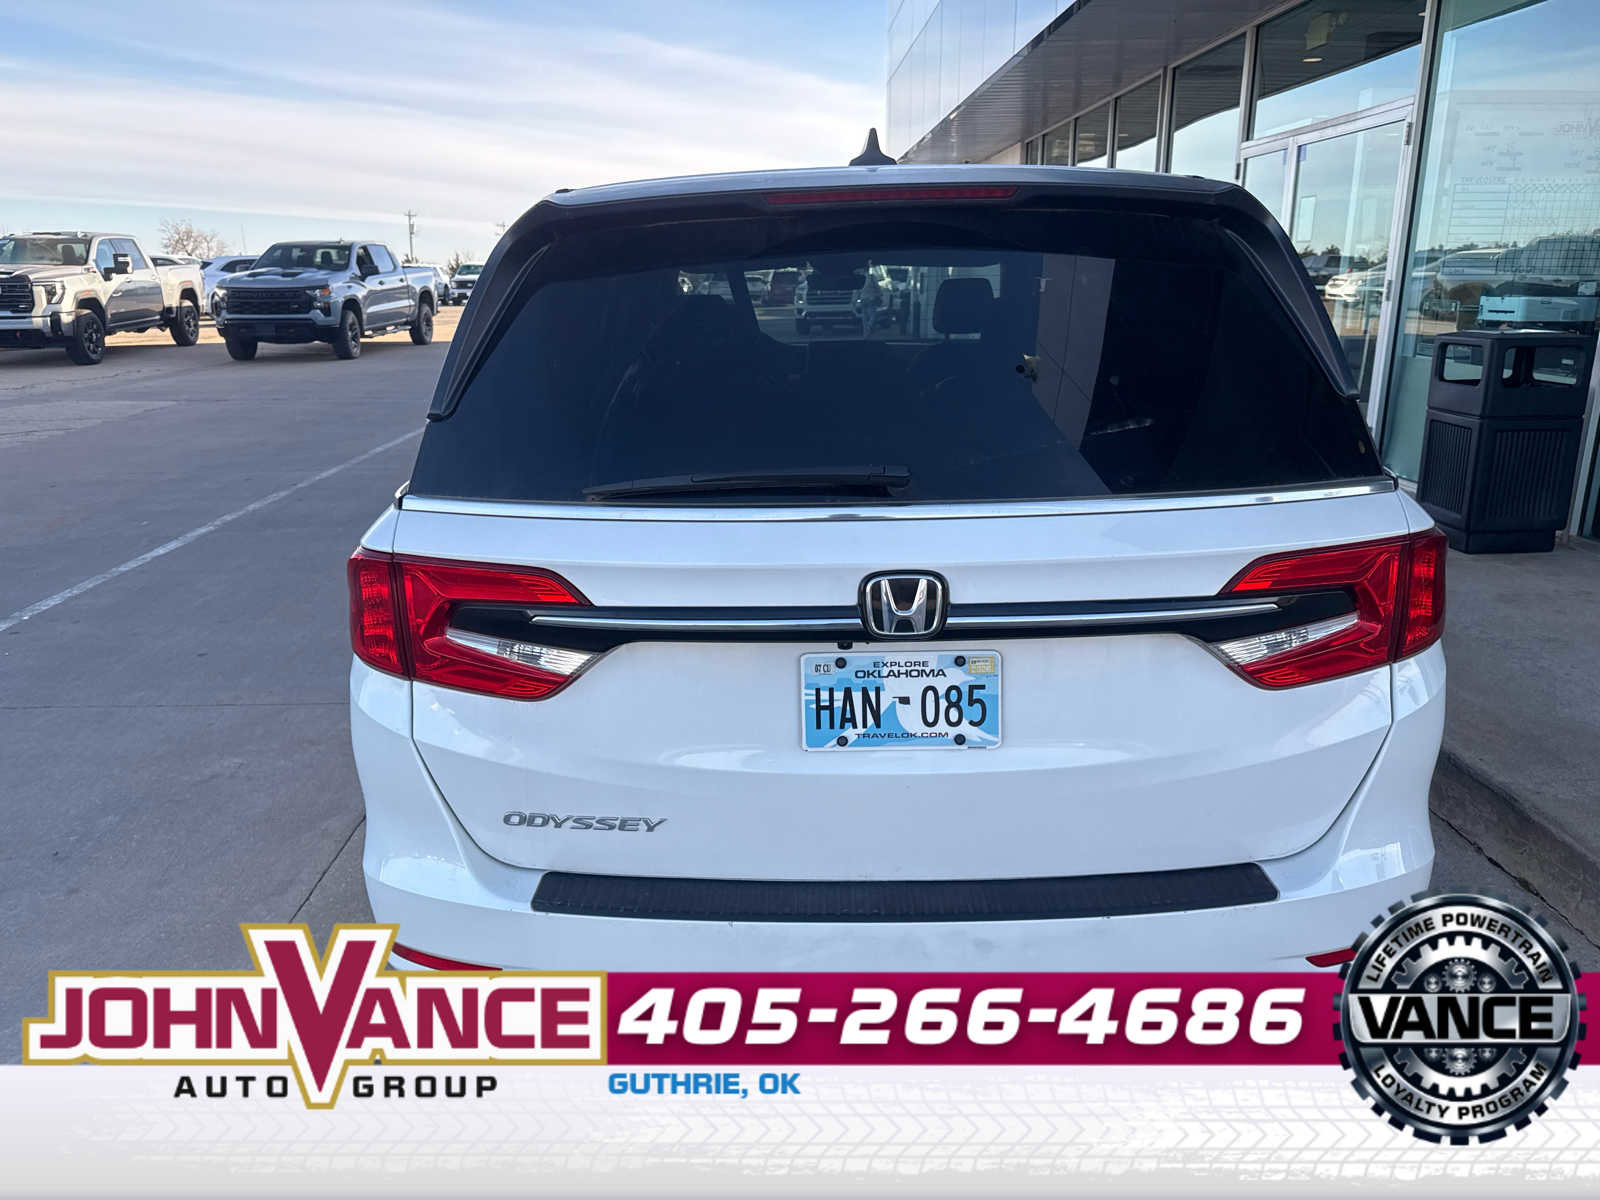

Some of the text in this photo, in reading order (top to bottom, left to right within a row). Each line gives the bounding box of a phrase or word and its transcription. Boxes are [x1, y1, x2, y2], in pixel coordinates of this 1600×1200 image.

[873, 660, 929, 668] EXPLORE
[855, 669, 947, 679] OKLAHOMA
[815, 684, 987, 729] HAN 085
[503, 811, 667, 832] ODYSSEY
